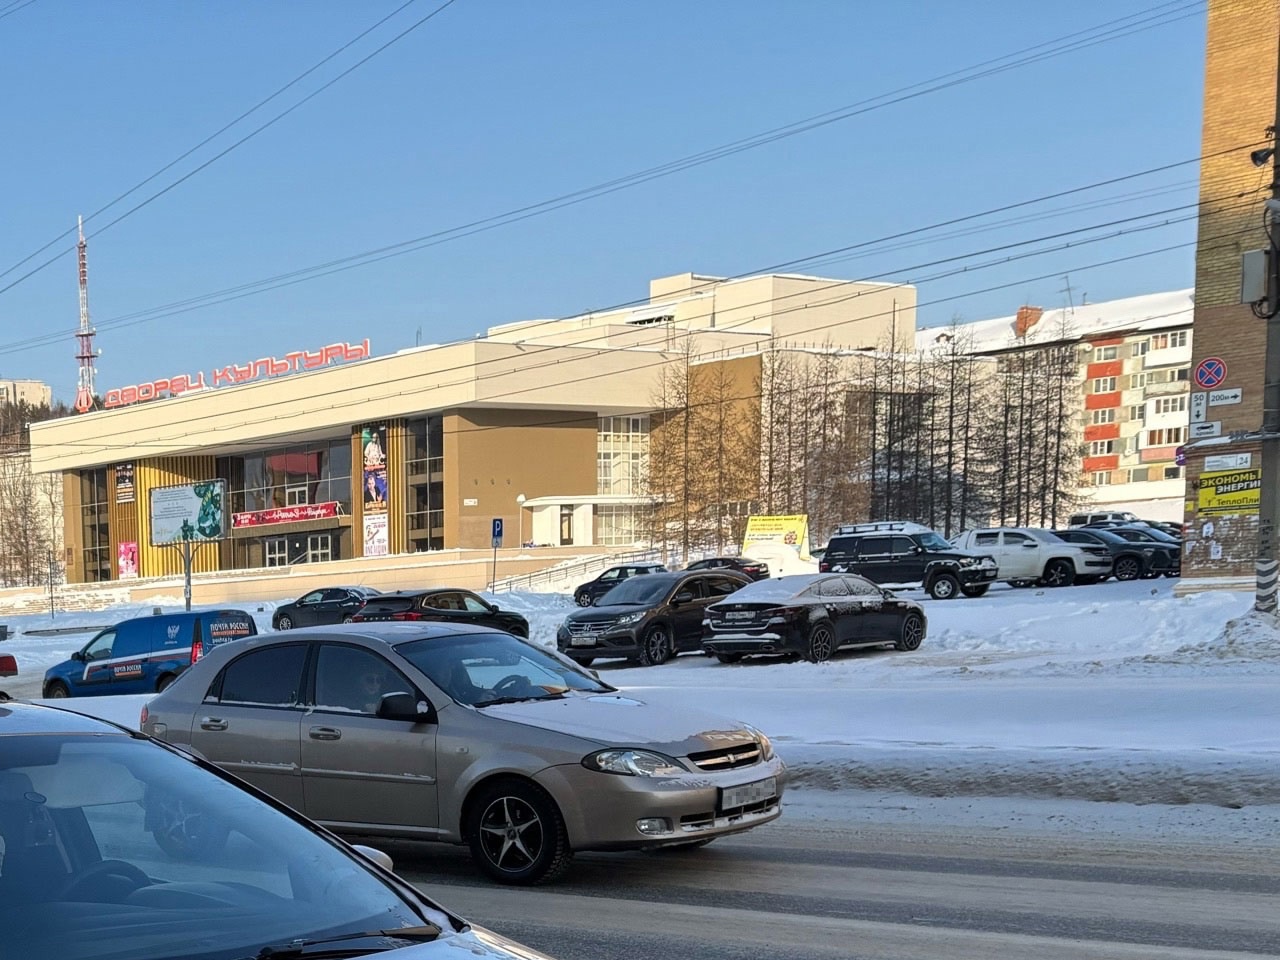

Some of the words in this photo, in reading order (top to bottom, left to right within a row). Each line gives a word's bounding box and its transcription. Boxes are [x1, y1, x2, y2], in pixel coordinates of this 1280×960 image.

[104, 371, 206, 408] ДВОРЕЦ
[212, 338, 370, 387] КУЛЬТУРЫ
[1239, 457, 1248, 465] 24
[1201, 472, 1257, 488] ЭКОНОМЬ
